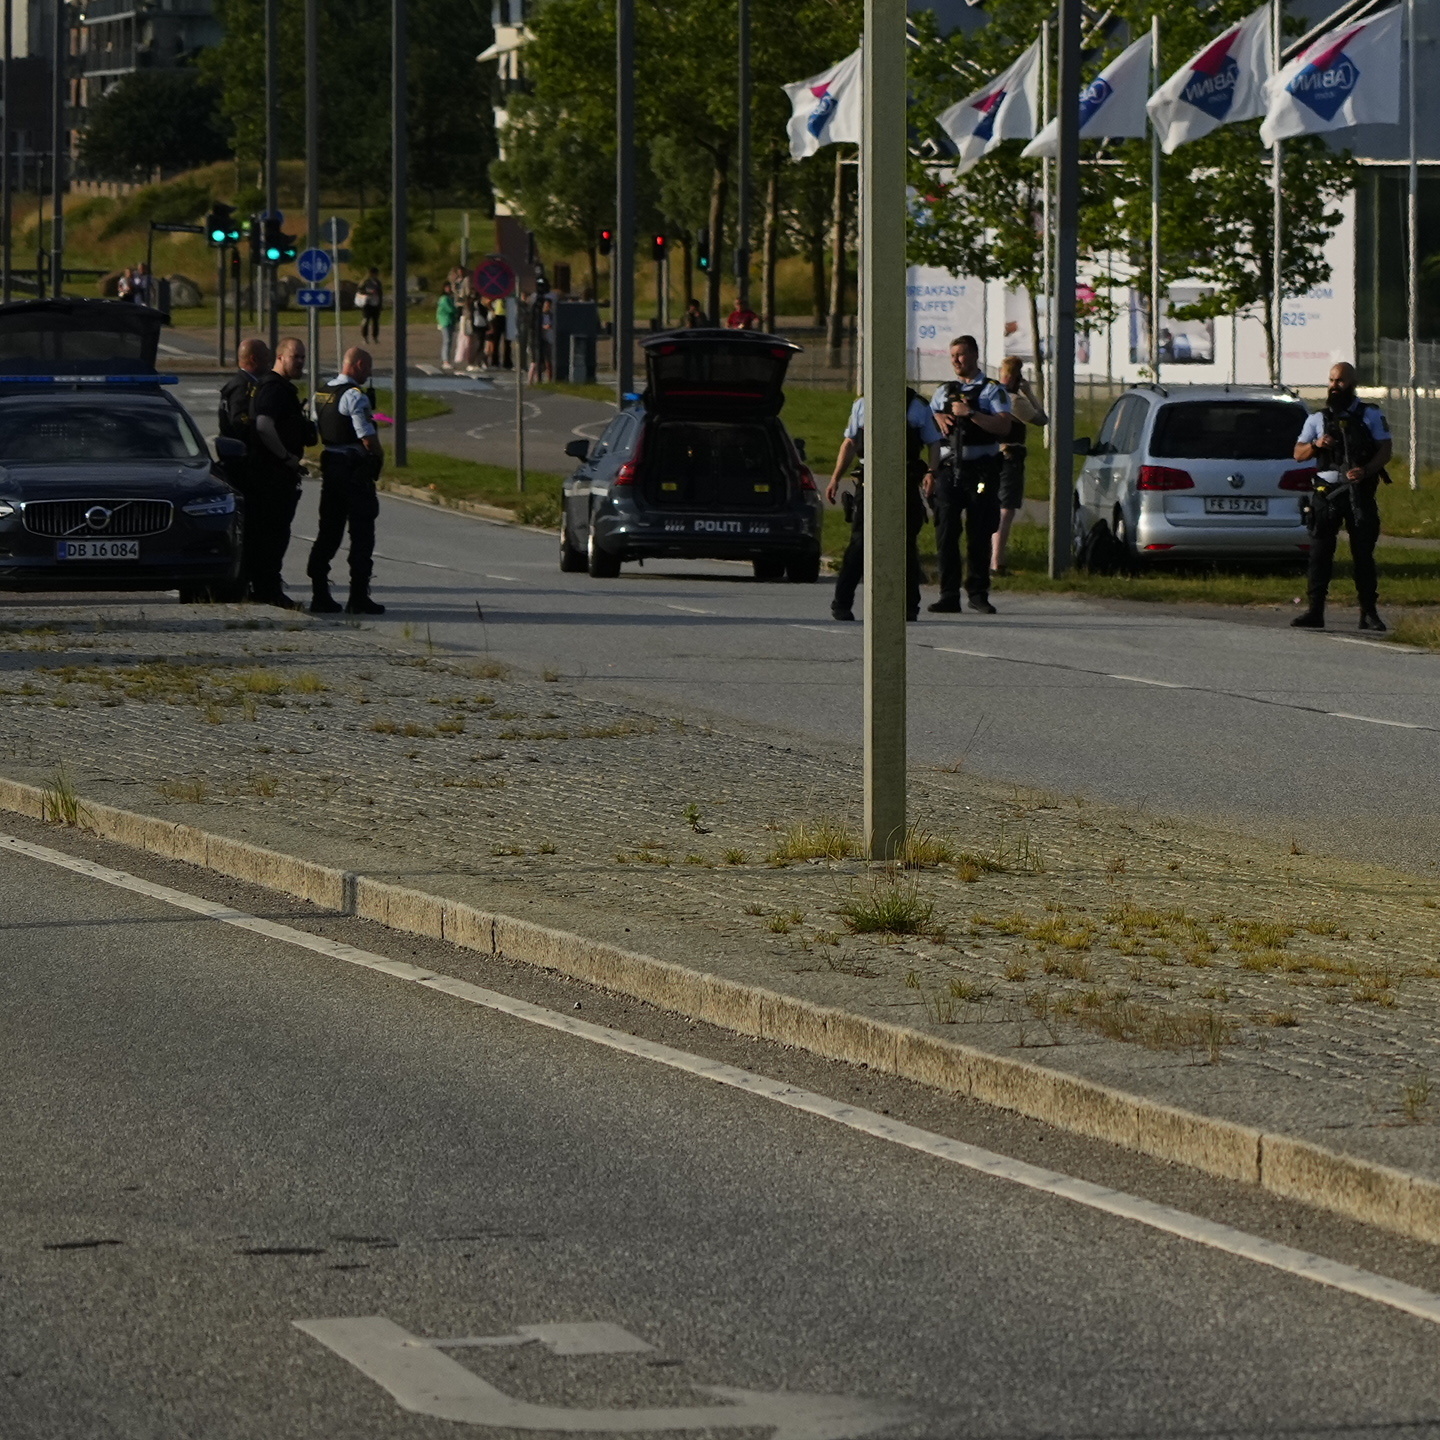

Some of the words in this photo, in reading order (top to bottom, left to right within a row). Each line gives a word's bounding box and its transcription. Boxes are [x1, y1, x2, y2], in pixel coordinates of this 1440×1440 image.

[912, 300, 955, 312] BUFFET
[918, 325, 936, 339] 99
[693, 519, 742, 533] POLITI
[67, 543, 87, 556] DB
[91, 543, 108, 556] 16
[111, 543, 137, 556] 084
